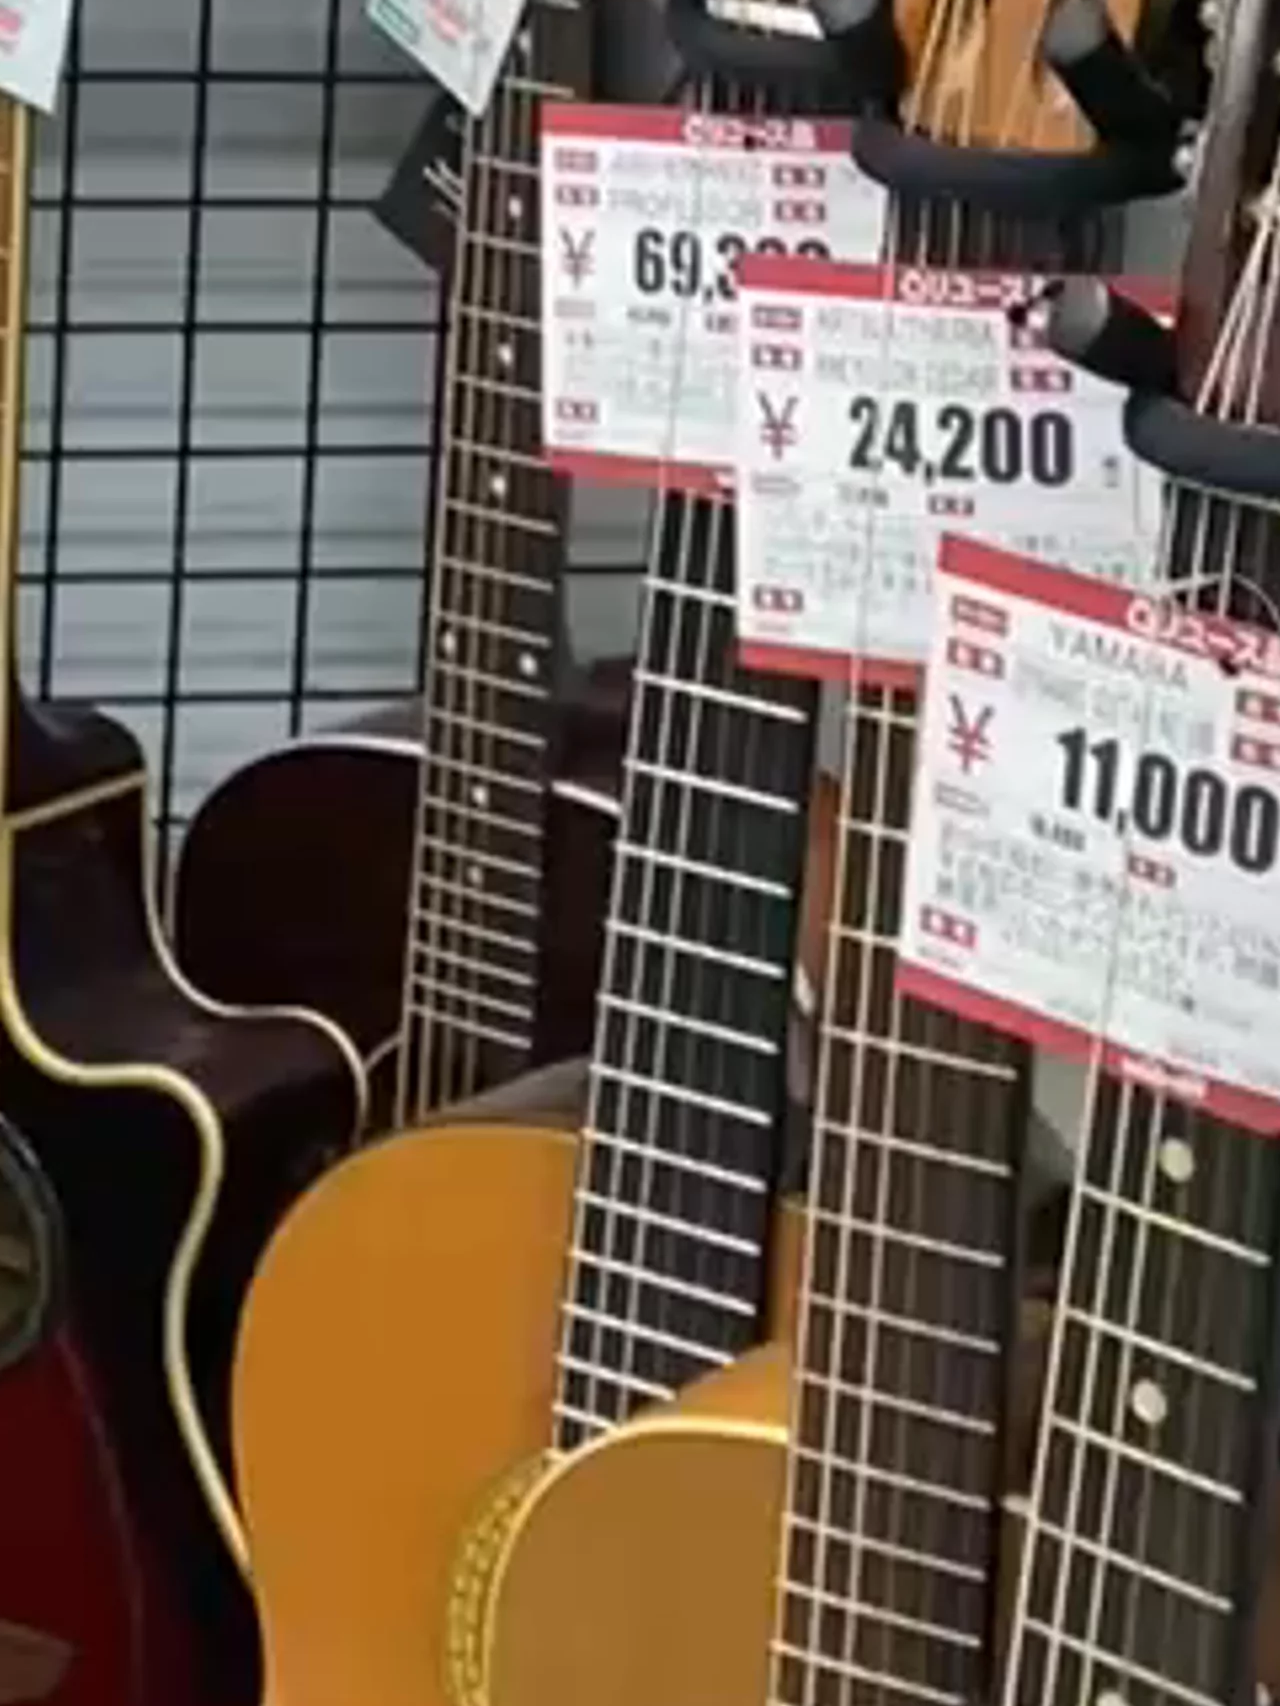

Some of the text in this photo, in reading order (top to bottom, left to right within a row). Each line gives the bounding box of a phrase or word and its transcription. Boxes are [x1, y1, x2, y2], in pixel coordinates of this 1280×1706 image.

[635, 229, 832, 303] 69,3
[916, 270, 1042, 306] リユース
[757, 393, 1073, 485] ¥ 24,200
[948, 694, 994, 774] ¥
[1055, 725, 1280, 876] 11,000
